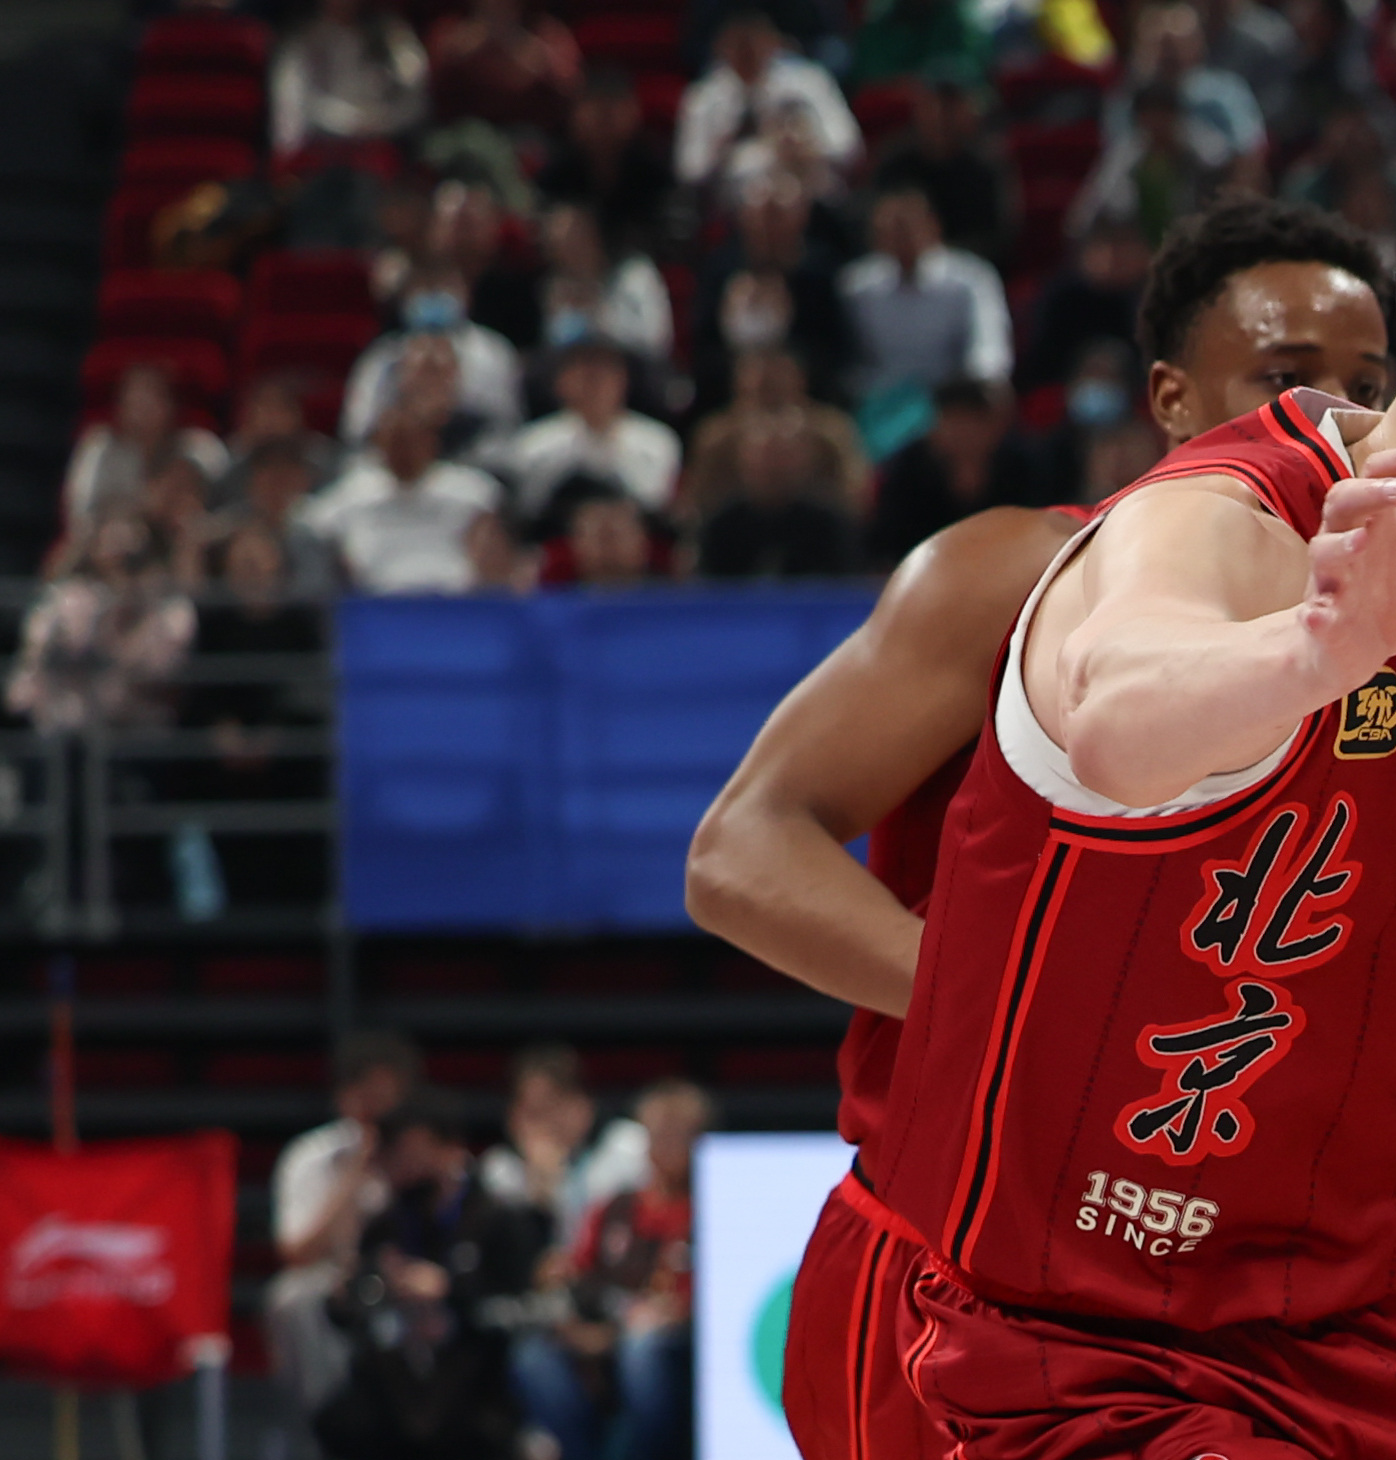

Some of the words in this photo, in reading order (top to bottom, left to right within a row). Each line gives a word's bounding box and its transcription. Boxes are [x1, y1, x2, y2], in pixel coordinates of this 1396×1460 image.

[1122, 796, 1356, 1160] 北京
[1075, 1206, 1202, 1256] SINCE
[1082, 1170, 1220, 1238] 1956
